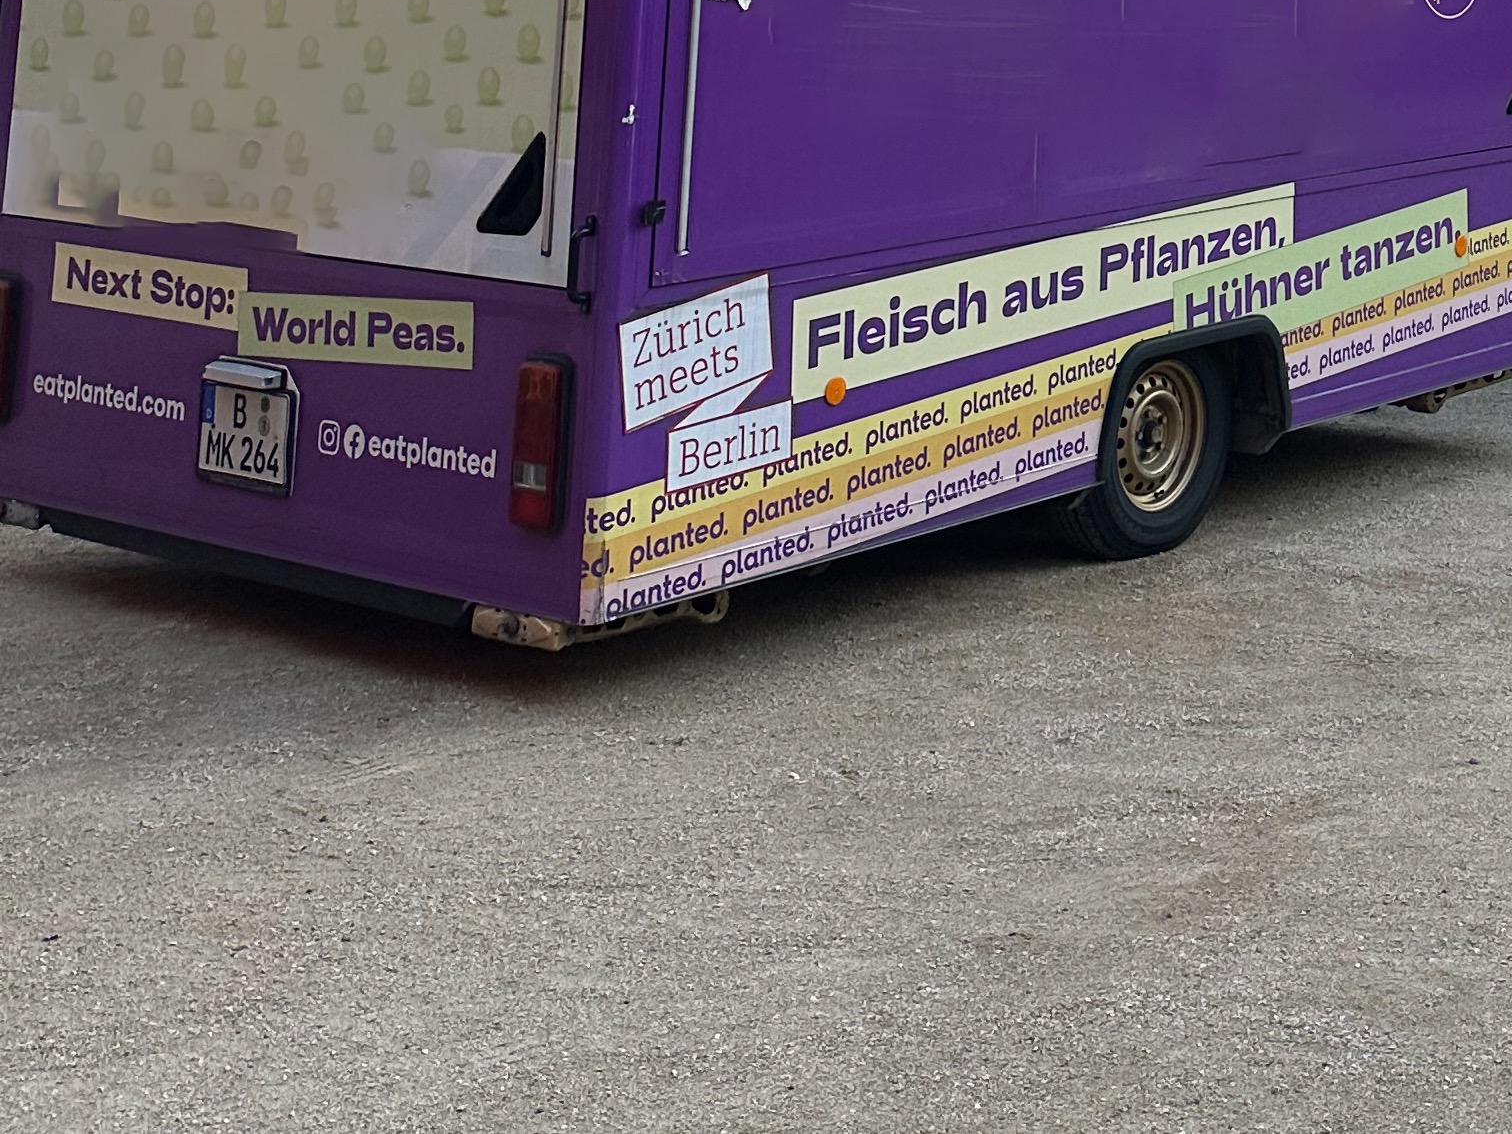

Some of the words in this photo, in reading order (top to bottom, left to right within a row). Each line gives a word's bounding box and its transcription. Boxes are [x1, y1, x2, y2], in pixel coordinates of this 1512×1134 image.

[1468, 227, 1509, 256] lanted.
[67, 256, 142, 299] Next
[150, 269, 235, 320] Stop:
[808, 281, 987, 369] Fleisch
[1001, 265, 1084, 318] aus
[1099, 216, 1285, 292] Pflanzen,
[1186, 257, 1330, 329] Hühner
[1331, 298, 1387, 337] planted.
[1394, 277, 1445, 316] planted.
[1452, 260, 1500, 297] planted.
[252, 306, 356, 347] World
[367, 311, 465, 353] Peas.
[632, 298, 746, 368] Zürich
[1319, 334, 1375, 375] planted.
[1382, 316, 1434, 352] planted.
[1441, 298, 1490, 332] planted.
[33, 373, 185, 421] eatplanted.com
[233, 393, 247, 428] B
[634, 344, 739, 411] meets
[678, 421, 780, 477] Berlin
[762, 432, 852, 487] planted.
[865, 402, 948, 454] planted.
[960, 374, 1037, 423] planted.
[1047, 348, 1119, 395] planted.
[205, 429, 236, 469] MK
[240, 436, 279, 478] 264
[368, 435, 497, 478] eatplanted
[629, 512, 728, 573] planted.
[743, 478, 834, 534] planted.
[847, 446, 931, 501] planted.
[943, 416, 1021, 467] planted.
[1032, 389, 1104, 437] planted.
[721, 525, 813, 584] planted.
[827, 492, 912, 548] planted.
[925, 461, 1004, 514] planted.
[1015, 432, 1088, 482] planted.
